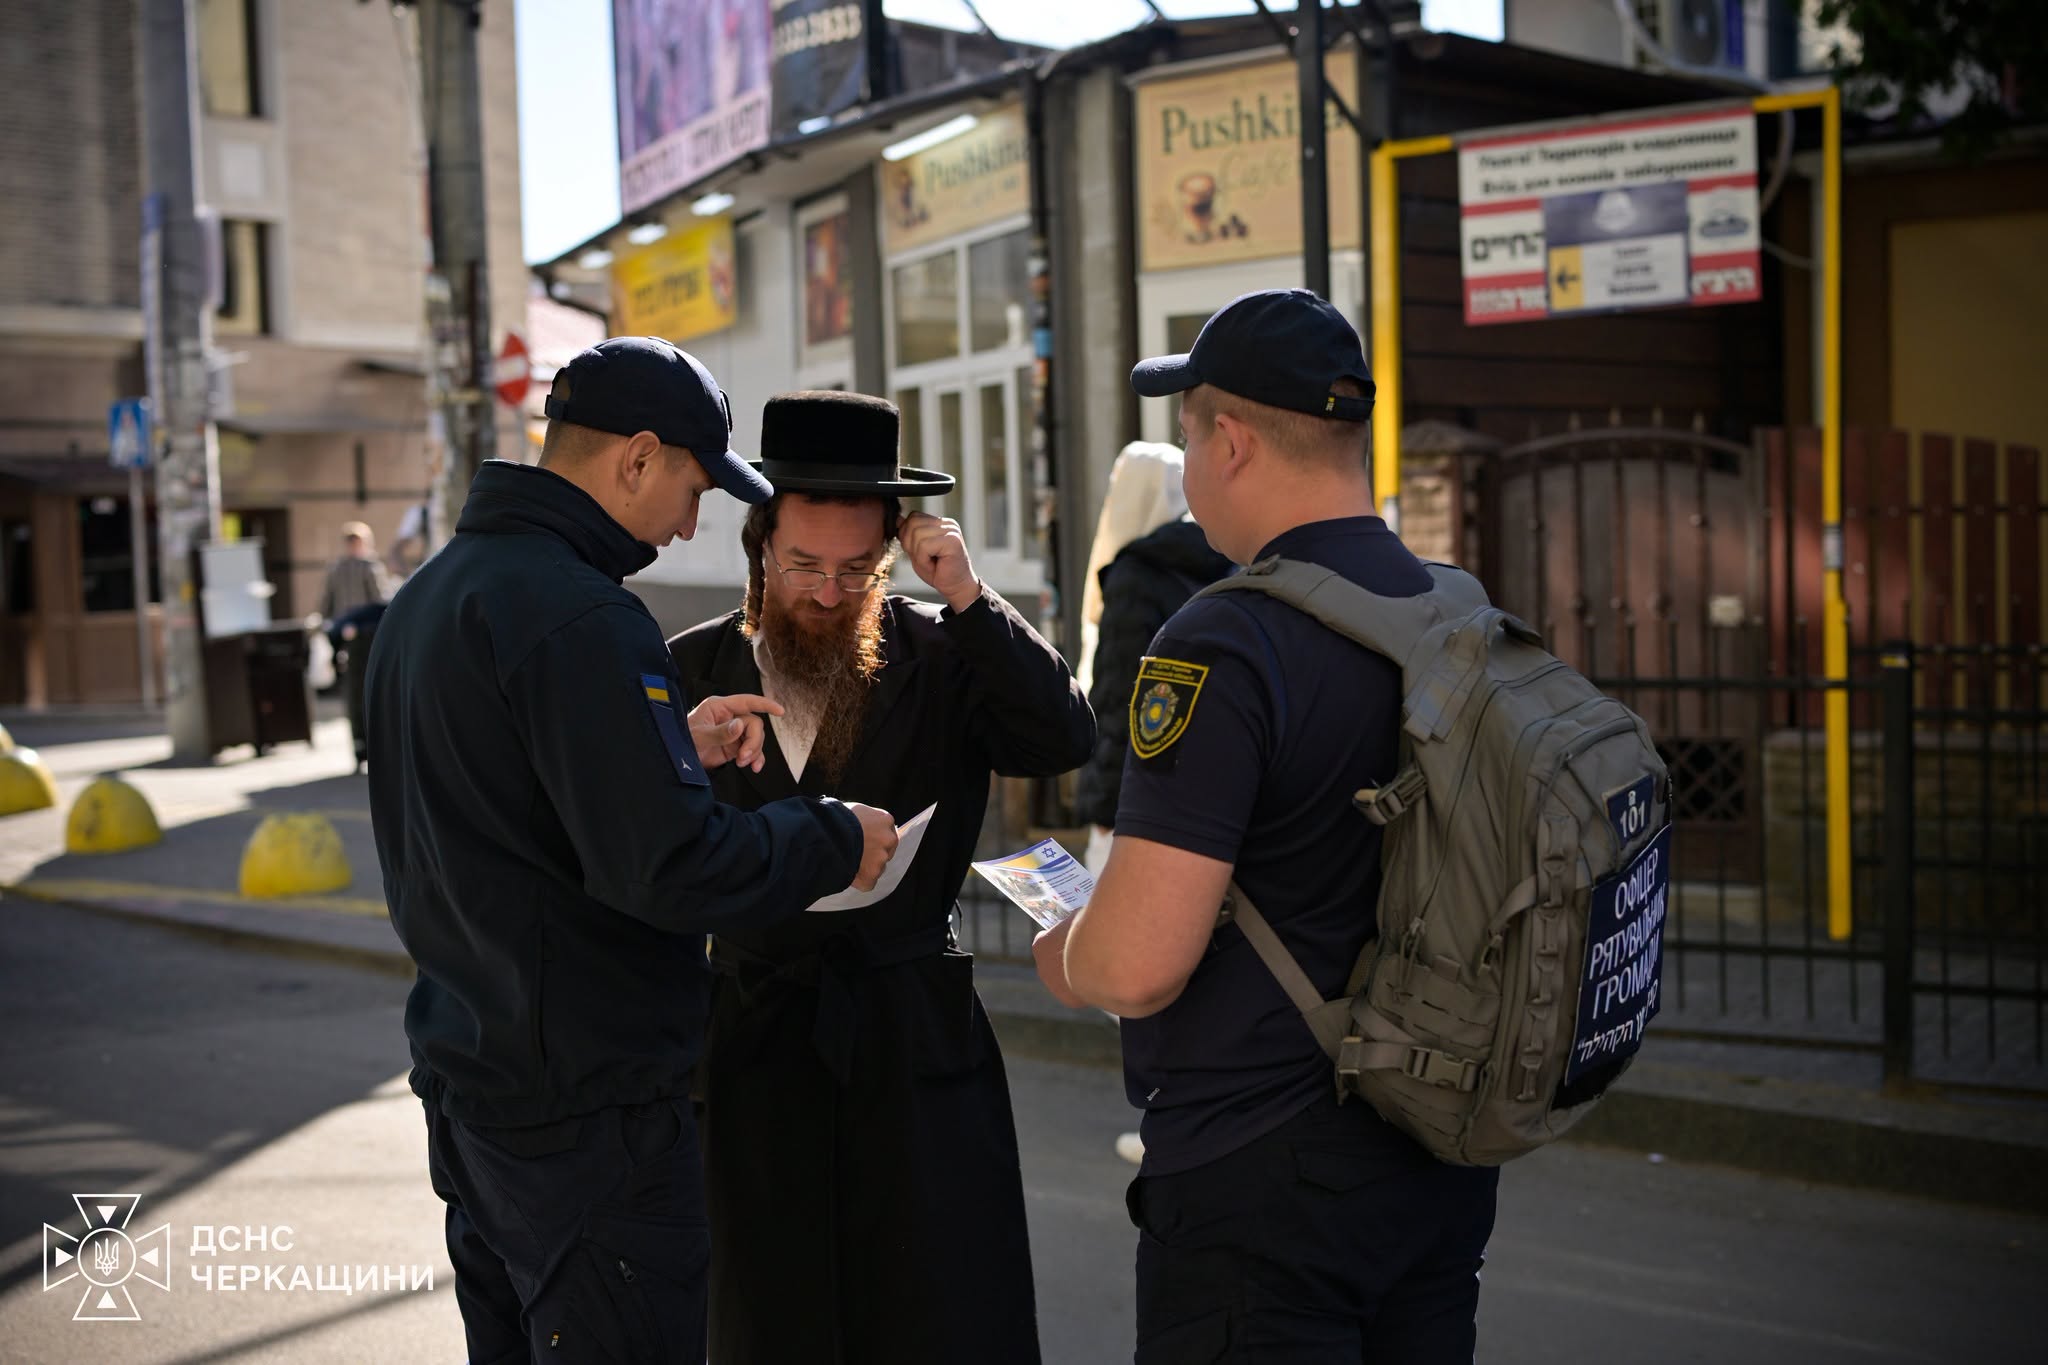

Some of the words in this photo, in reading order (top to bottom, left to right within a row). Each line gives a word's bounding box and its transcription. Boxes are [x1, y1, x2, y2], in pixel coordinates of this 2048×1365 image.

[1161, 91, 1345, 155] Pushkia
[1619, 800, 1646, 838] 101
[1614, 848, 1658, 919] ОФІЦЕР
